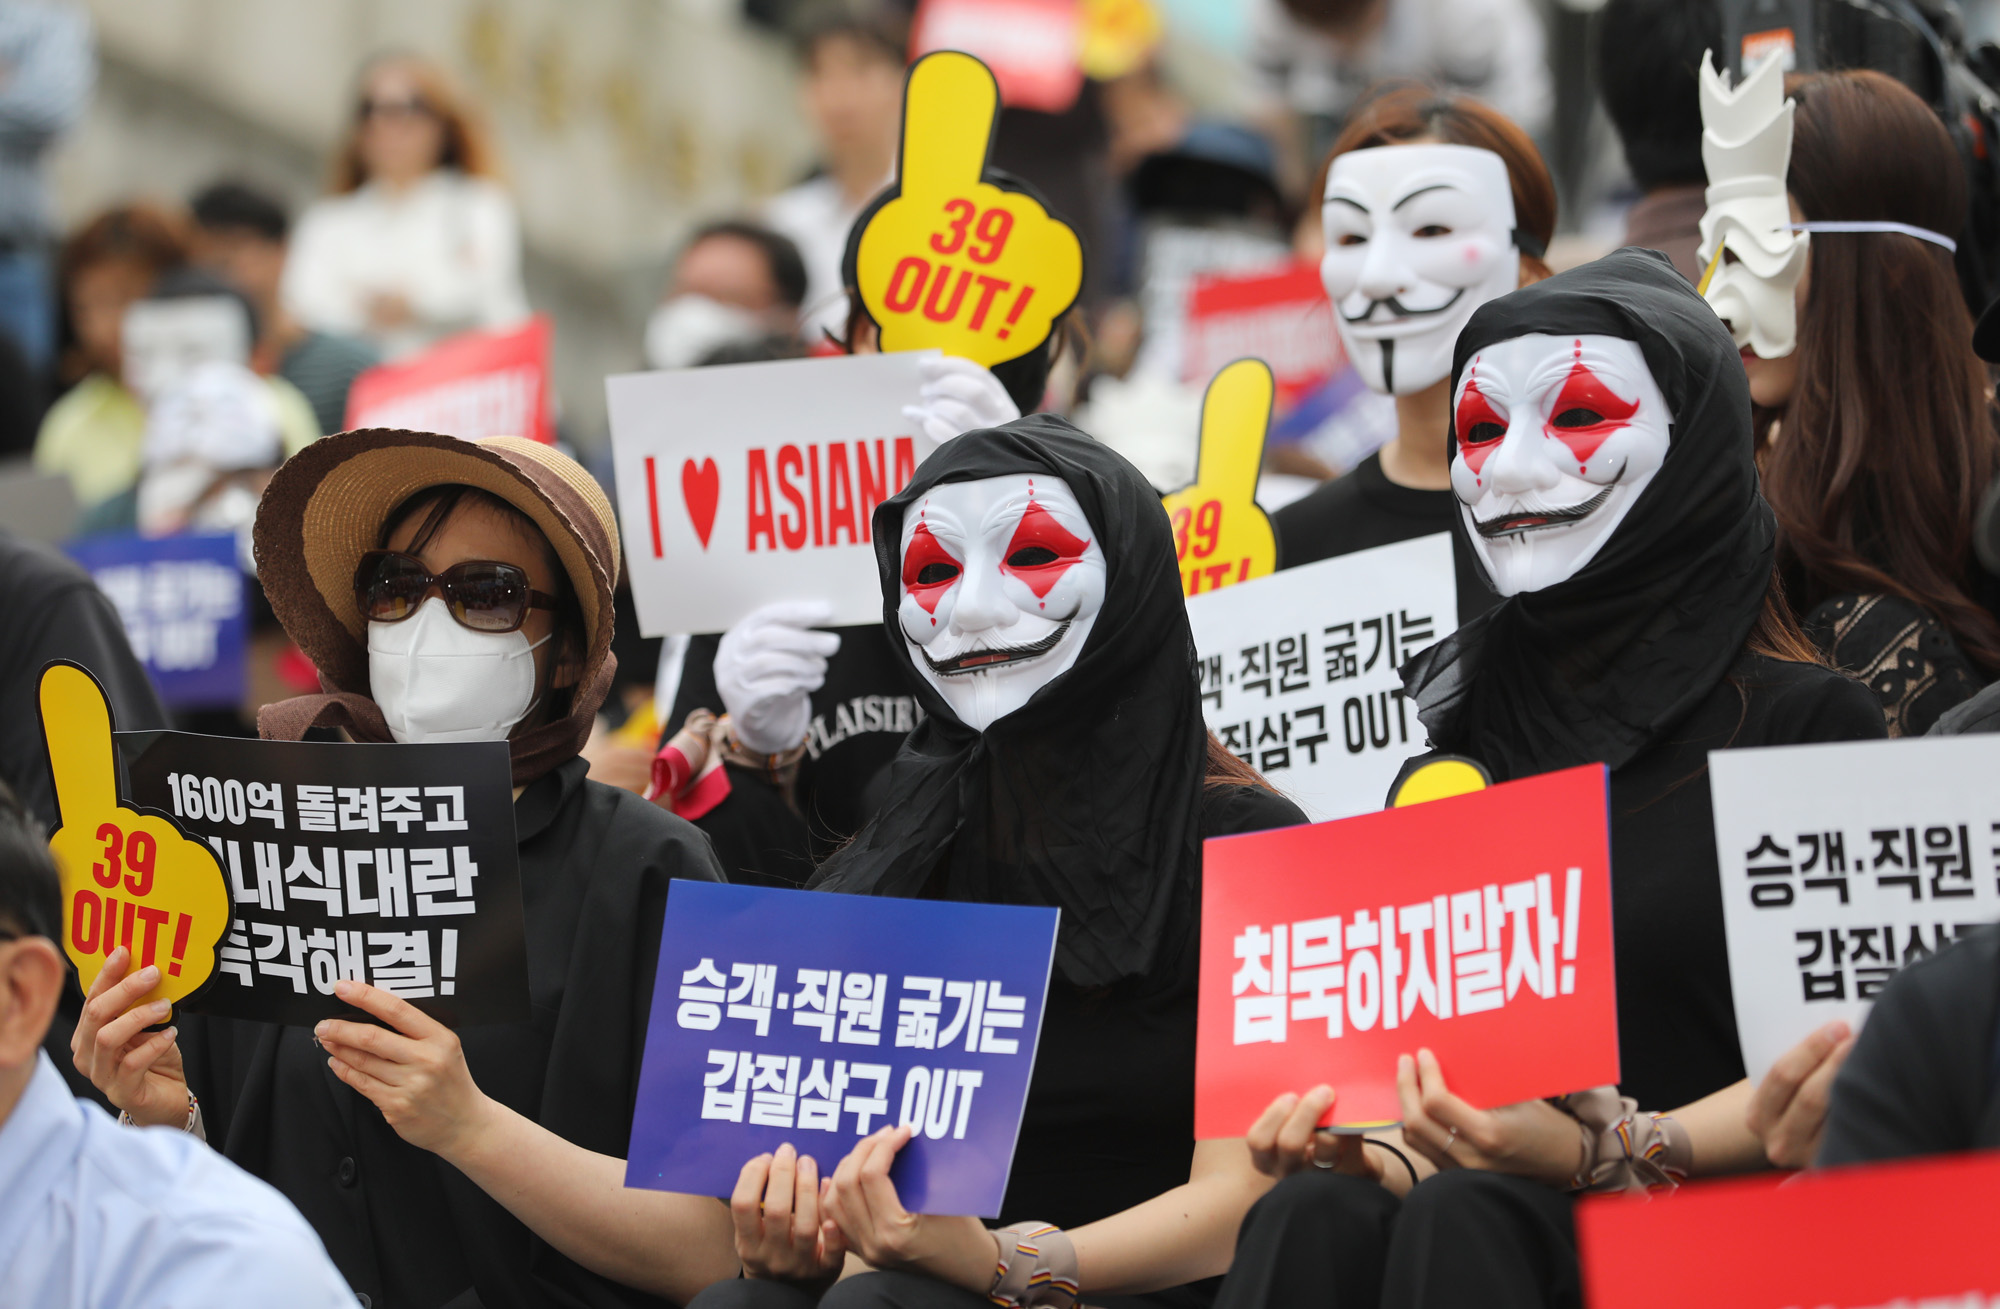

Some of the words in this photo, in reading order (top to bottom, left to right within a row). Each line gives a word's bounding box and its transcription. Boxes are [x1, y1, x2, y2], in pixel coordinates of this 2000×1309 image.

[929, 198, 1014, 265] 39
[883, 256, 1035, 341] OUT!
[645, 456, 664, 559] I
[1198, 632, 1310, 710] 객·직원
[1343, 687, 1408, 754] OUT
[167, 772, 285, 829] 1600억
[296, 784, 468, 833] 돌려주고
[92, 822, 157, 897] 39
[71, 889, 193, 978] OUT!
[1232, 867, 1582, 1046] 침묵하지말자!
[894, 975, 1027, 1055] 굶기는
[700, 1048, 892, 1136] 갑질삼구
[899, 1065, 984, 1140] OUT
